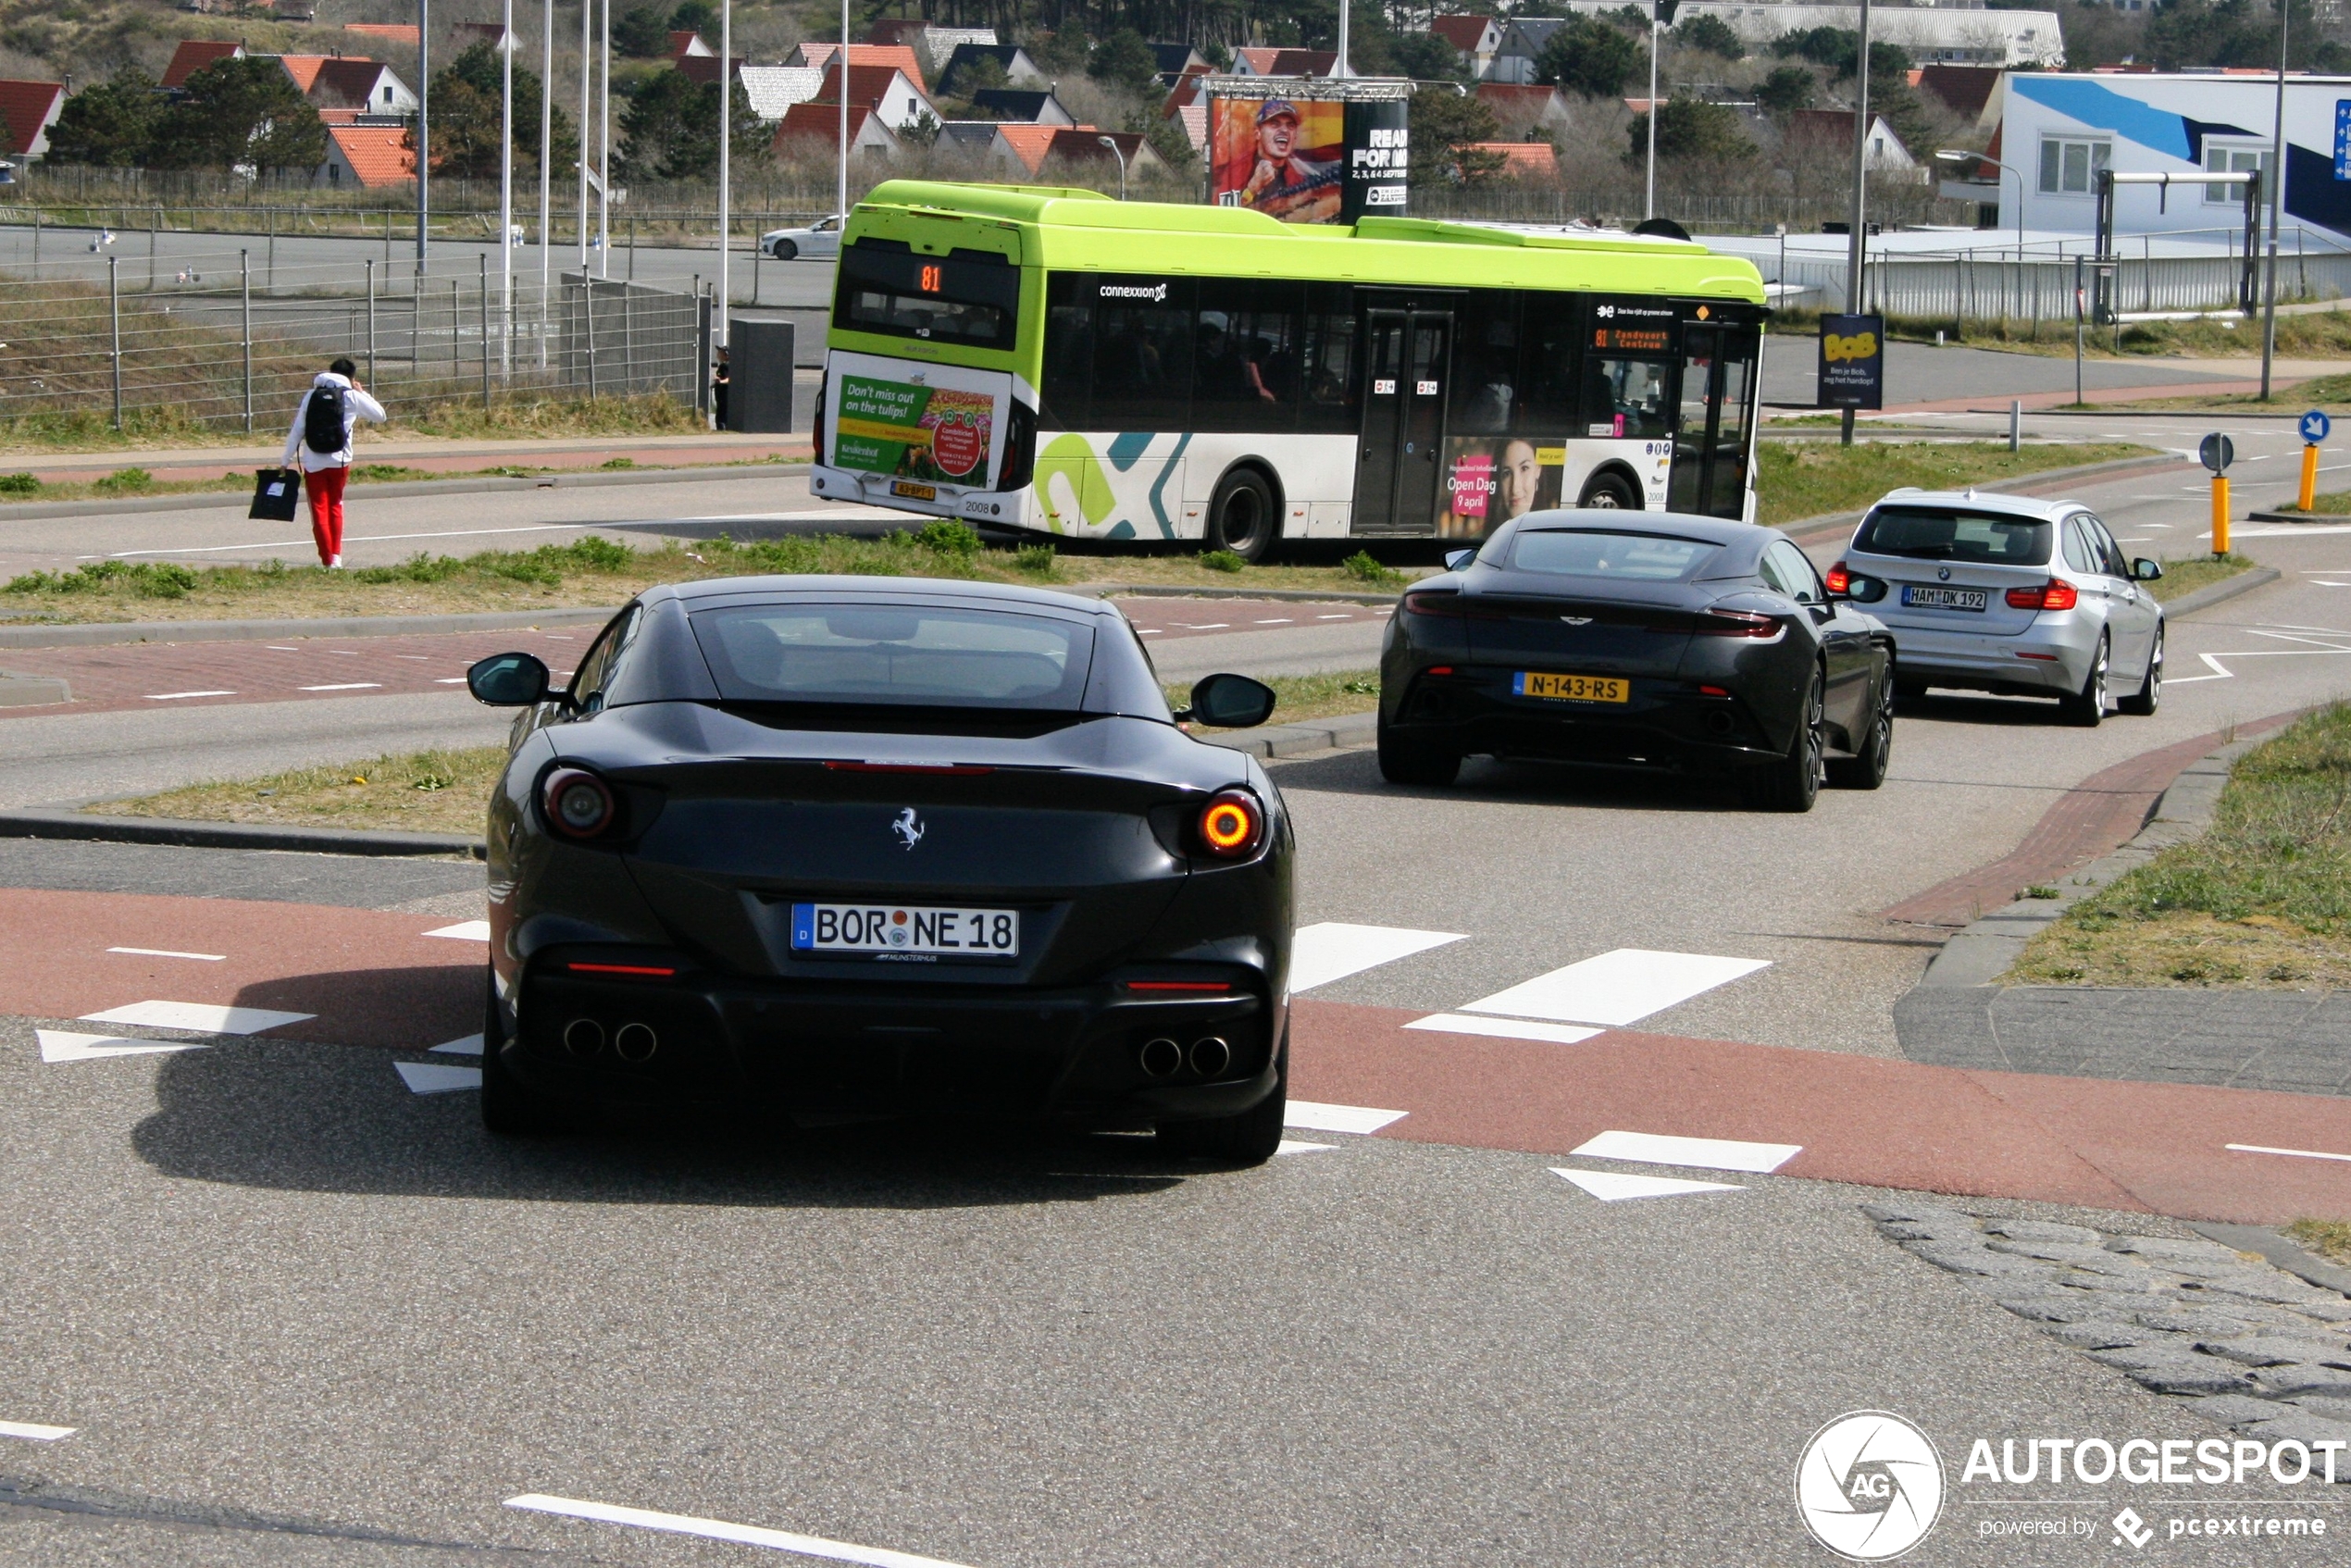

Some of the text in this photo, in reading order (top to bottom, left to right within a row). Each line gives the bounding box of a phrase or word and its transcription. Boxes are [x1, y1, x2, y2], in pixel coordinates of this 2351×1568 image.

[1352, 149, 1390, 168] FOR
[922, 266, 940, 292] 81
[1100, 285, 1155, 298] connexxion
[1619, 340, 1661, 349] Centrum
[1823, 332, 1877, 362] BOB
[1847, 377, 1873, 386] hardop!
[847, 383, 915, 404] Don't miss out
[846, 402, 908, 419] on the tulips!
[841, 444, 878, 457] Keukenhof
[1447, 477, 1497, 495] Open Dag
[1457, 495, 1483, 510] 9 april
[1648, 492, 1664, 502] 2008
[965, 501, 989, 514] 2008
[1911, 589, 1984, 606] HAM DK 192
[1532, 676, 1618, 699] N-143-RS
[800, 930, 808, 940] D
[816, 909, 1013, 949] BOR NE 18
